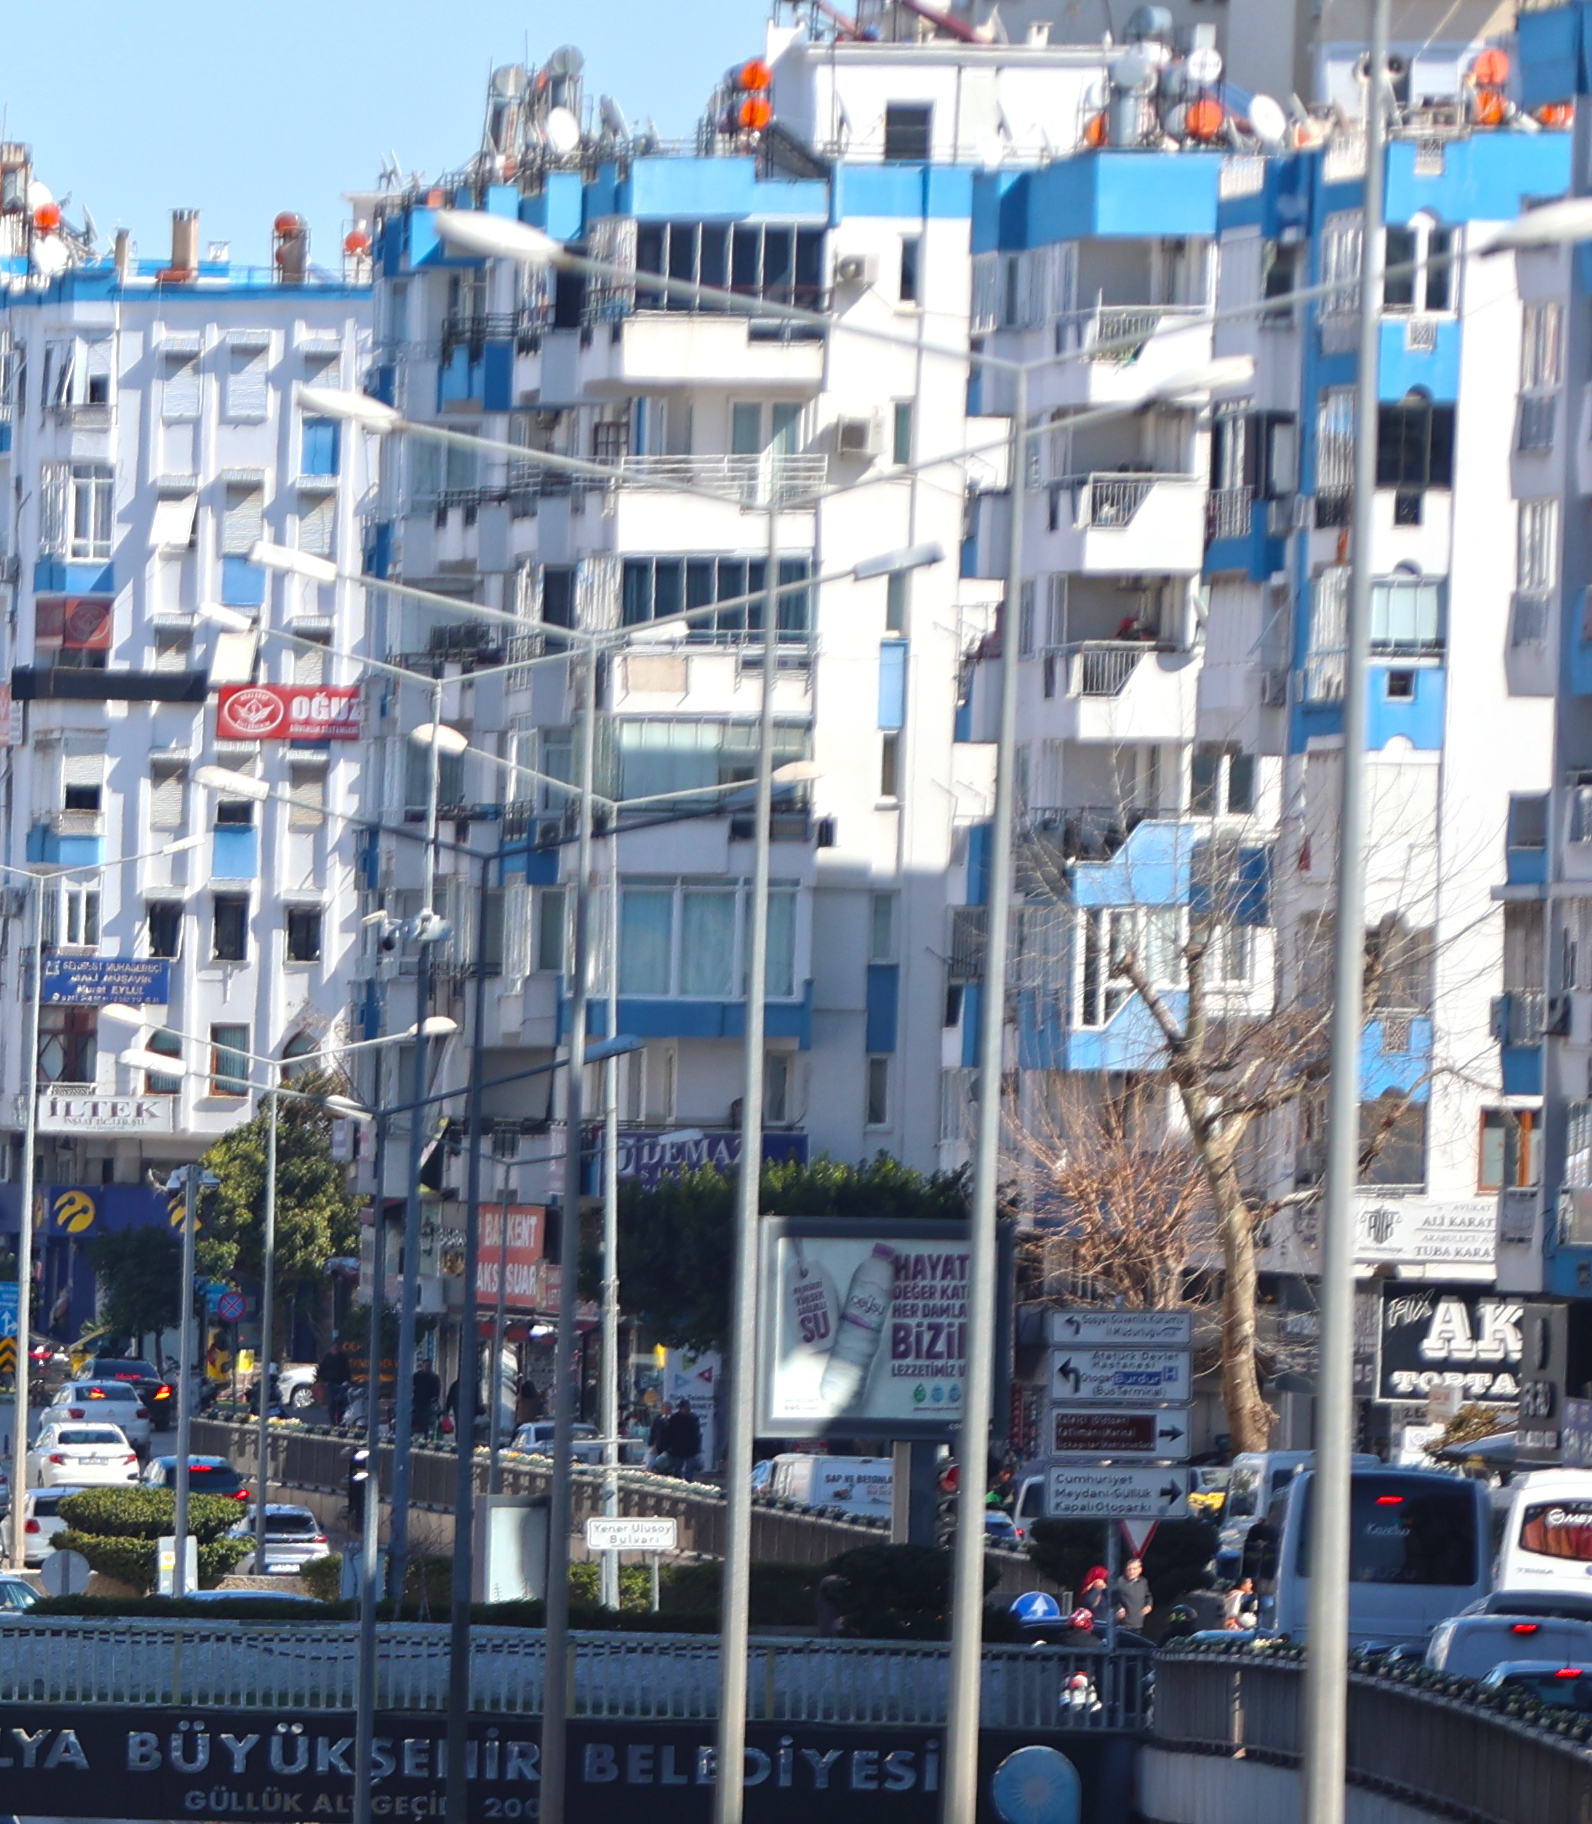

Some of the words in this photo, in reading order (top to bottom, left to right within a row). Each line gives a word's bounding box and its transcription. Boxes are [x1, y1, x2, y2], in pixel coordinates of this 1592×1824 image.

[48, 1097, 162, 1118] İLTEK
[485, 1213, 538, 1248] BAKENT
[477, 1261, 537, 1295] AKSSUAR
[800, 1310, 831, 1343] SU
[892, 1303, 919, 1318] HER
[593, 1523, 628, 1533] Yener
[631, 1523, 672, 1535] Ulusoy
[609, 1534, 660, 1544] Bulvarı
[584, 1735, 939, 1793] BELEDİYESİ
[184, 1785, 303, 1814] GÜLLÜK
[371, 1789, 448, 1822] GEÇİ
[484, 1797, 541, 1818] 200
